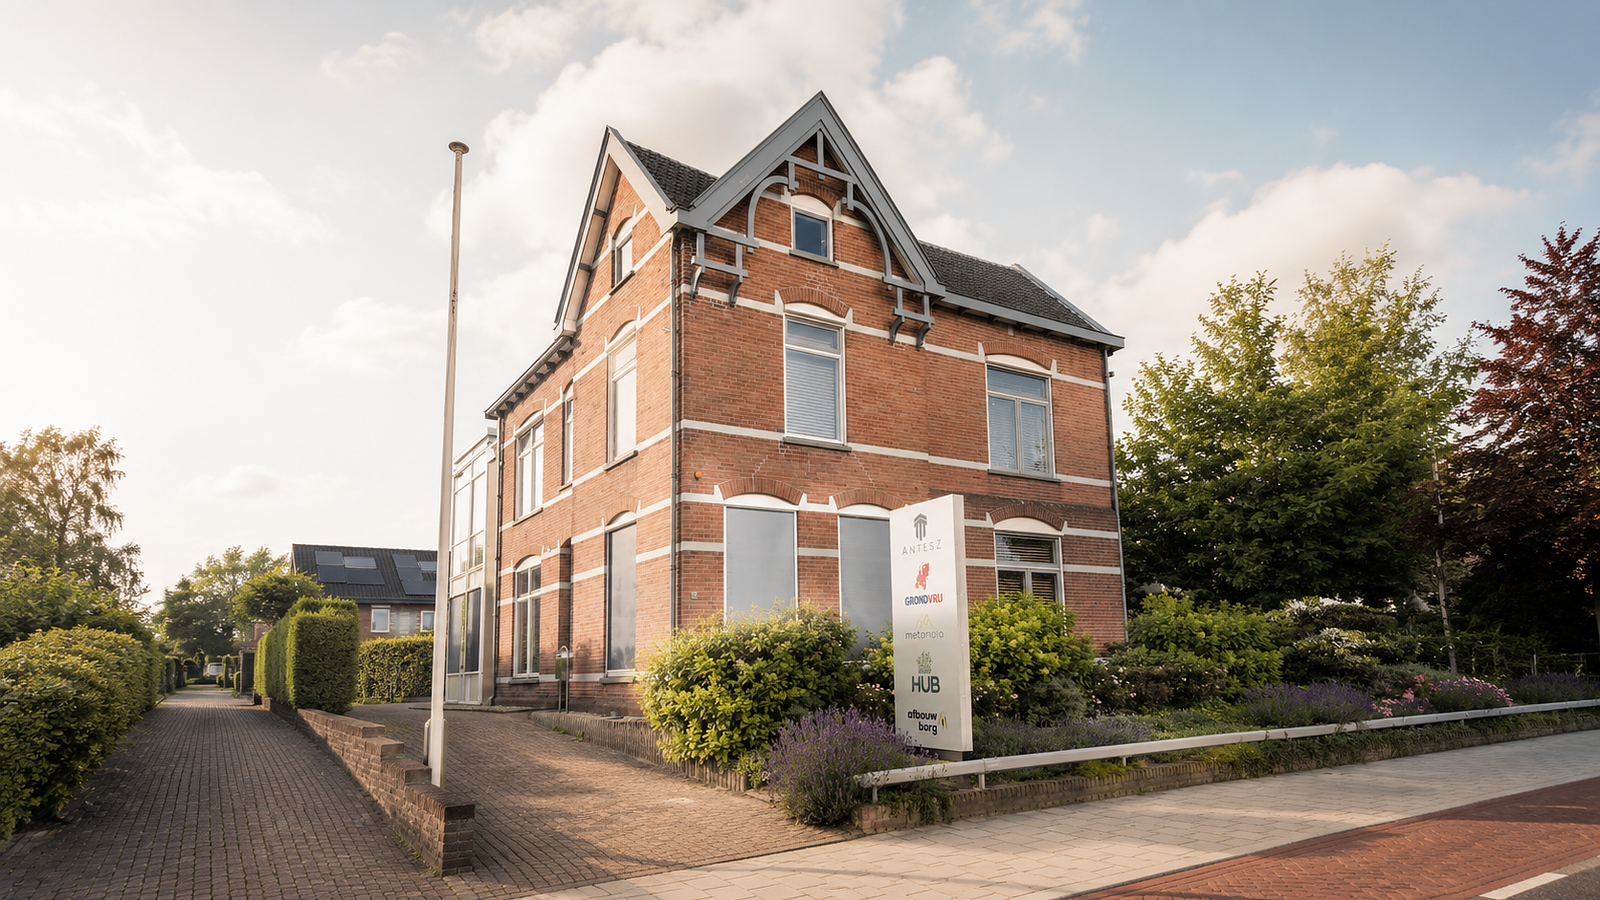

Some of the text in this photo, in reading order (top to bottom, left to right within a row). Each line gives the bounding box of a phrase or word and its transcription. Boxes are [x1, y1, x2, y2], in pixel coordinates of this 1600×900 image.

[902, 539, 942, 555] ANTESZ
[911, 675, 941, 693] HUB
[907, 709, 938, 721] afbouw
[918, 721, 938, 736] borg
